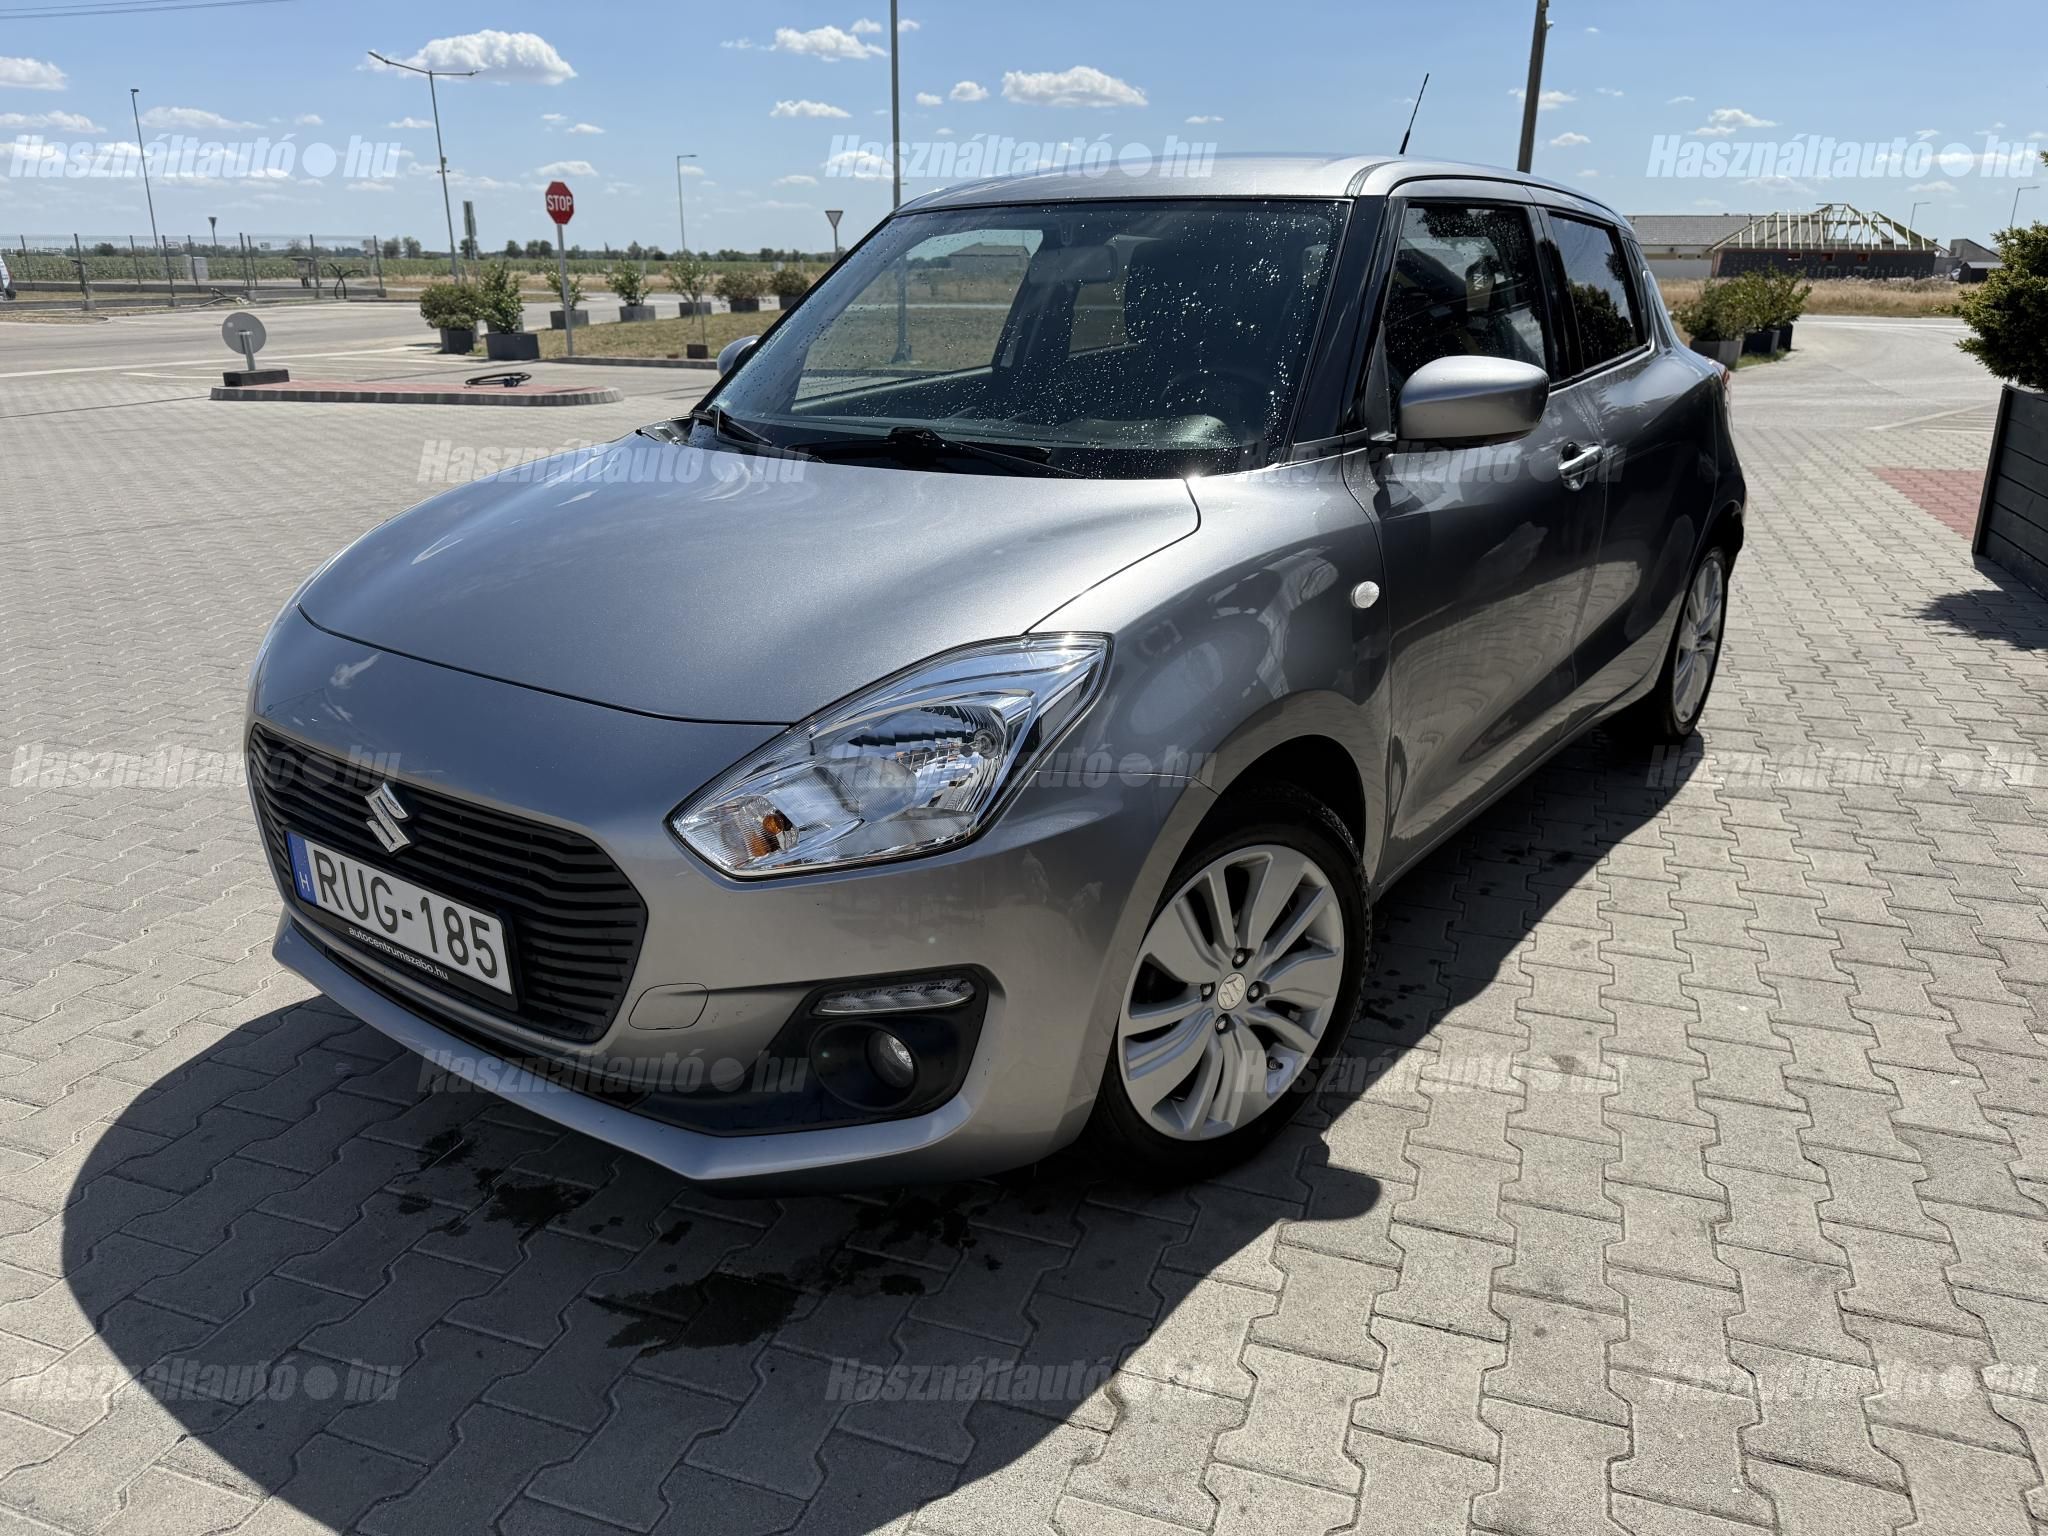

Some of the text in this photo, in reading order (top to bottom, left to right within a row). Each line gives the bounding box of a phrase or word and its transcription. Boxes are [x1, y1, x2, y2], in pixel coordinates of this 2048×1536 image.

[547, 195, 572, 211] STOP
[299, 871, 311, 892] H
[313, 849, 498, 979] RUG-185
[348, 927, 449, 981] autocentrumszabo.hu
